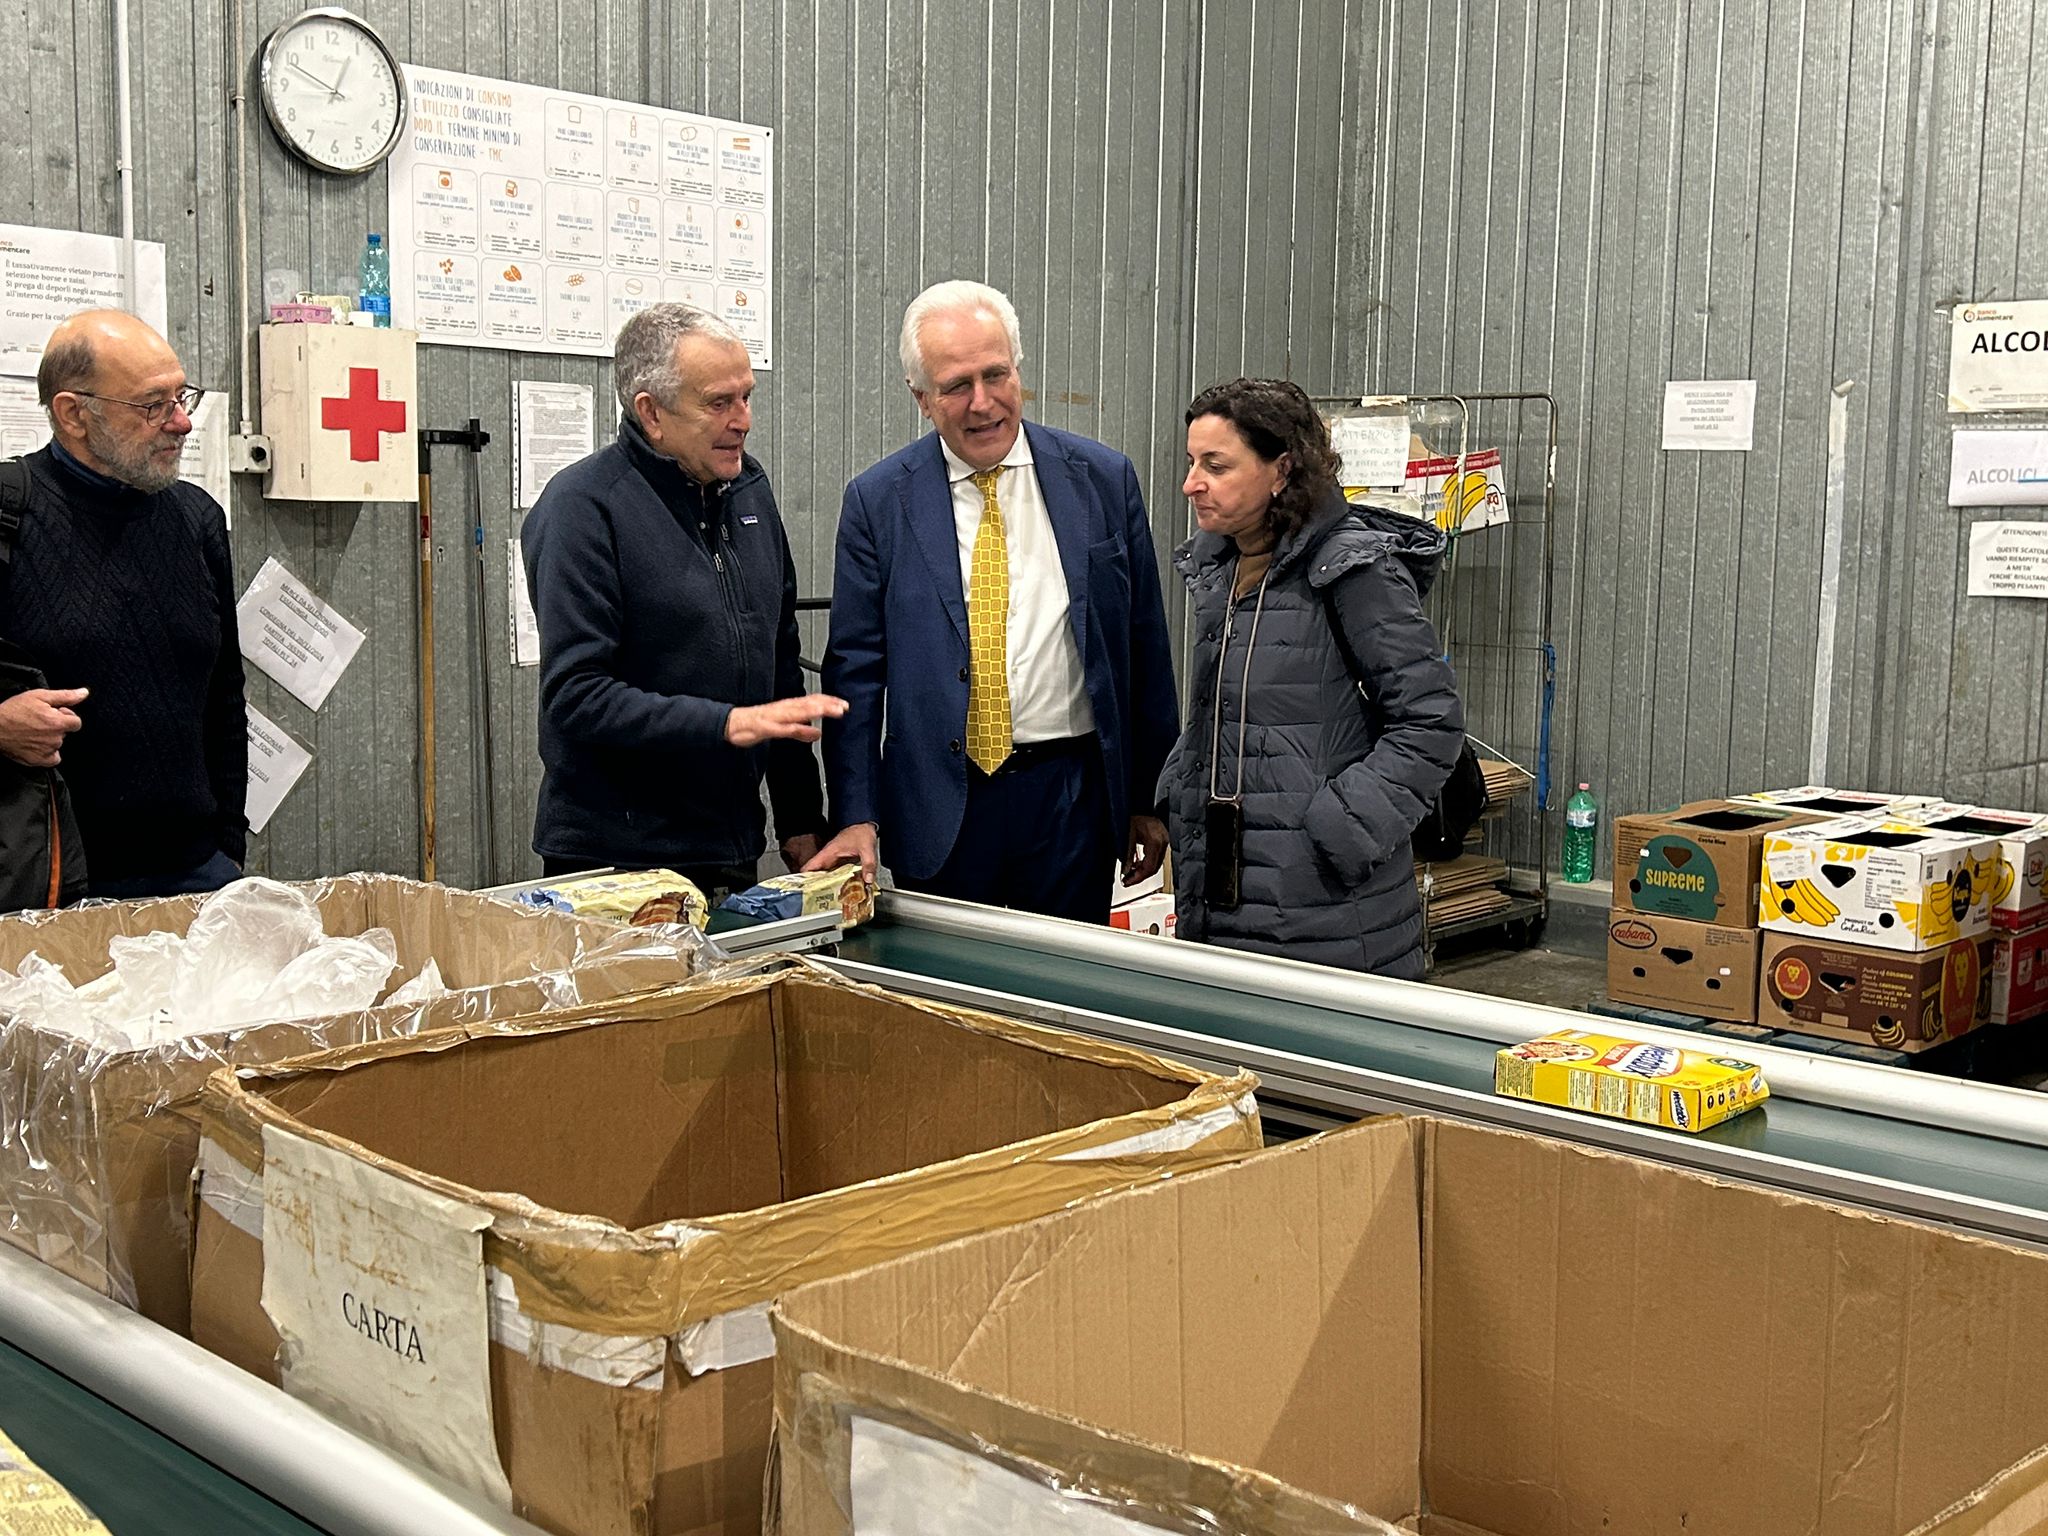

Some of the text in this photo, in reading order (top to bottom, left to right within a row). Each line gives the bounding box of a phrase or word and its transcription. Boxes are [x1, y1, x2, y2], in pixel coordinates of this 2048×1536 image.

[304, 36, 314, 50] 11
[326, 31, 339, 46] 12
[286, 52, 299, 66] 10
[372, 64, 380, 78] 2
[280, 78, 289, 92] 9
[378, 93, 386, 107] 3
[414, 79, 512, 108] INDICAZIONI DI CONSUMO
[288, 107, 296, 122] 8
[414, 98, 512, 126] E UTILIZZO CONSIGLIATE
[371, 120, 380, 134] 4
[414, 117, 520, 146] DOPO IL TERMINE MINIMO DI
[306, 129, 315, 144] 7
[354, 136, 362, 150] 5
[330, 139, 339, 154] 6
[414, 136, 476, 159] CONSERVAZIONE
[488, 148, 503, 162] TMC
[6, 271, 40, 280] selezione
[42, 272, 62, 281] borse
[12, 262, 66, 274] tassativamente
[68, 266, 92, 275] vietato
[93, 270, 117, 280] portare
[15, 282, 35, 291] prega
[37, 282, 44, 290] di
[46, 284, 71, 294] deporli
[72, 286, 89, 295] negli
[6, 290, 44, 300] all'interno
[45, 294, 62, 302] degli
[6, 309, 30, 318] Grazie
[32, 312, 42, 320] per
[45, 312, 52, 320] la
[1996, 546, 2019, 554] QUESTE
[1614, 920, 1651, 941] cabana
[342, 1292, 426, 1364] CARTA
